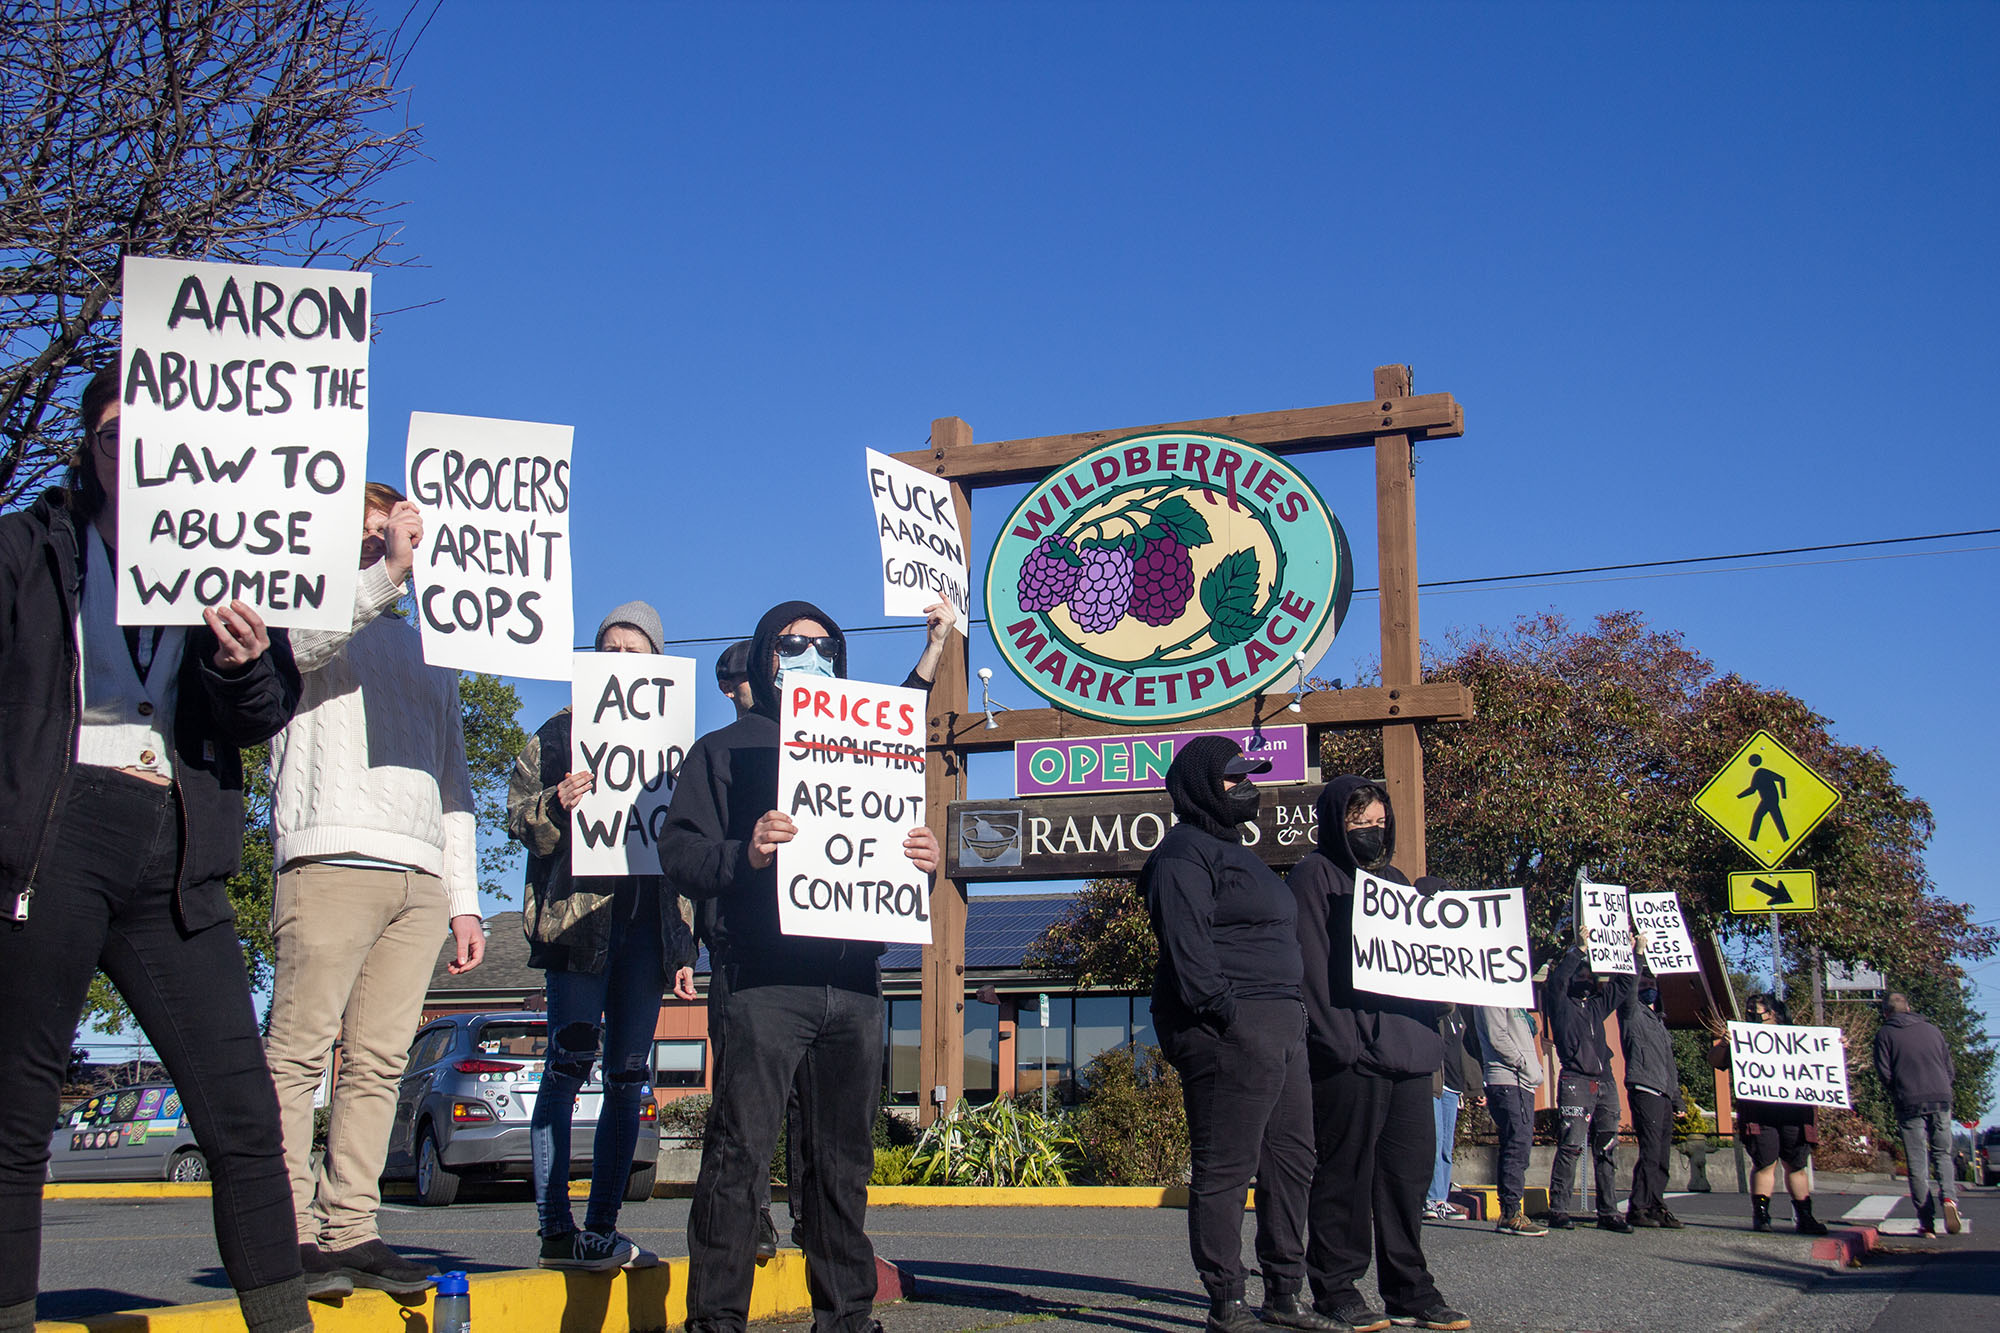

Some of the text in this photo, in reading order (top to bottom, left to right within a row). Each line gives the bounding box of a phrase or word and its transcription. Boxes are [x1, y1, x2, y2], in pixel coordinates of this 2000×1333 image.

[167, 274, 367, 343] AARON
[124, 348, 366, 416] ABUSES THE
[135, 438, 345, 494] LAW TO
[411, 448, 569, 515] GROCERS
[870, 468, 955, 531] FUCK
[1012, 443, 1309, 542] WILDBERRIES
[150, 509, 312, 555] ABUSE
[430, 519, 562, 582] AREN'T
[881, 512, 963, 566] AARON
[129, 565, 326, 610] WOMEN
[422, 585, 543, 644] COPS
[1007, 590, 1315, 707] MARKETPLACE
[593, 674, 675, 723] ACT
[793, 687, 914, 736] PRICES
[580, 741, 684, 794] YOUR
[789, 730, 925, 774] SHOPLIFTERS
[1029, 739, 1175, 785] OPEN
[791, 780, 923, 824] ARE OUT
[825, 834, 877, 868] OF
[789, 874, 928, 921] CONTROL
[1363, 878, 1511, 929] BOYCOTT
[1599, 913, 1617, 927] UP
[1604, 892, 1626, 913] BEAT
[1635, 900, 1678, 915] LOWER
[1589, 928, 1632, 946] CHILDREN
[1636, 916, 1680, 929] PRICES
[1353, 934, 1528, 983] WILDBERRIES
[1591, 948, 1612, 962] FOR
[1646, 940, 1680, 954] LESS
[1649, 955, 1693, 968] THEFT
[1732, 1029, 1830, 1055] HONK IF
[1735, 1059, 1841, 1085] YOU HATE
[1737, 1081, 1847, 1105] CHILD ABUSE
